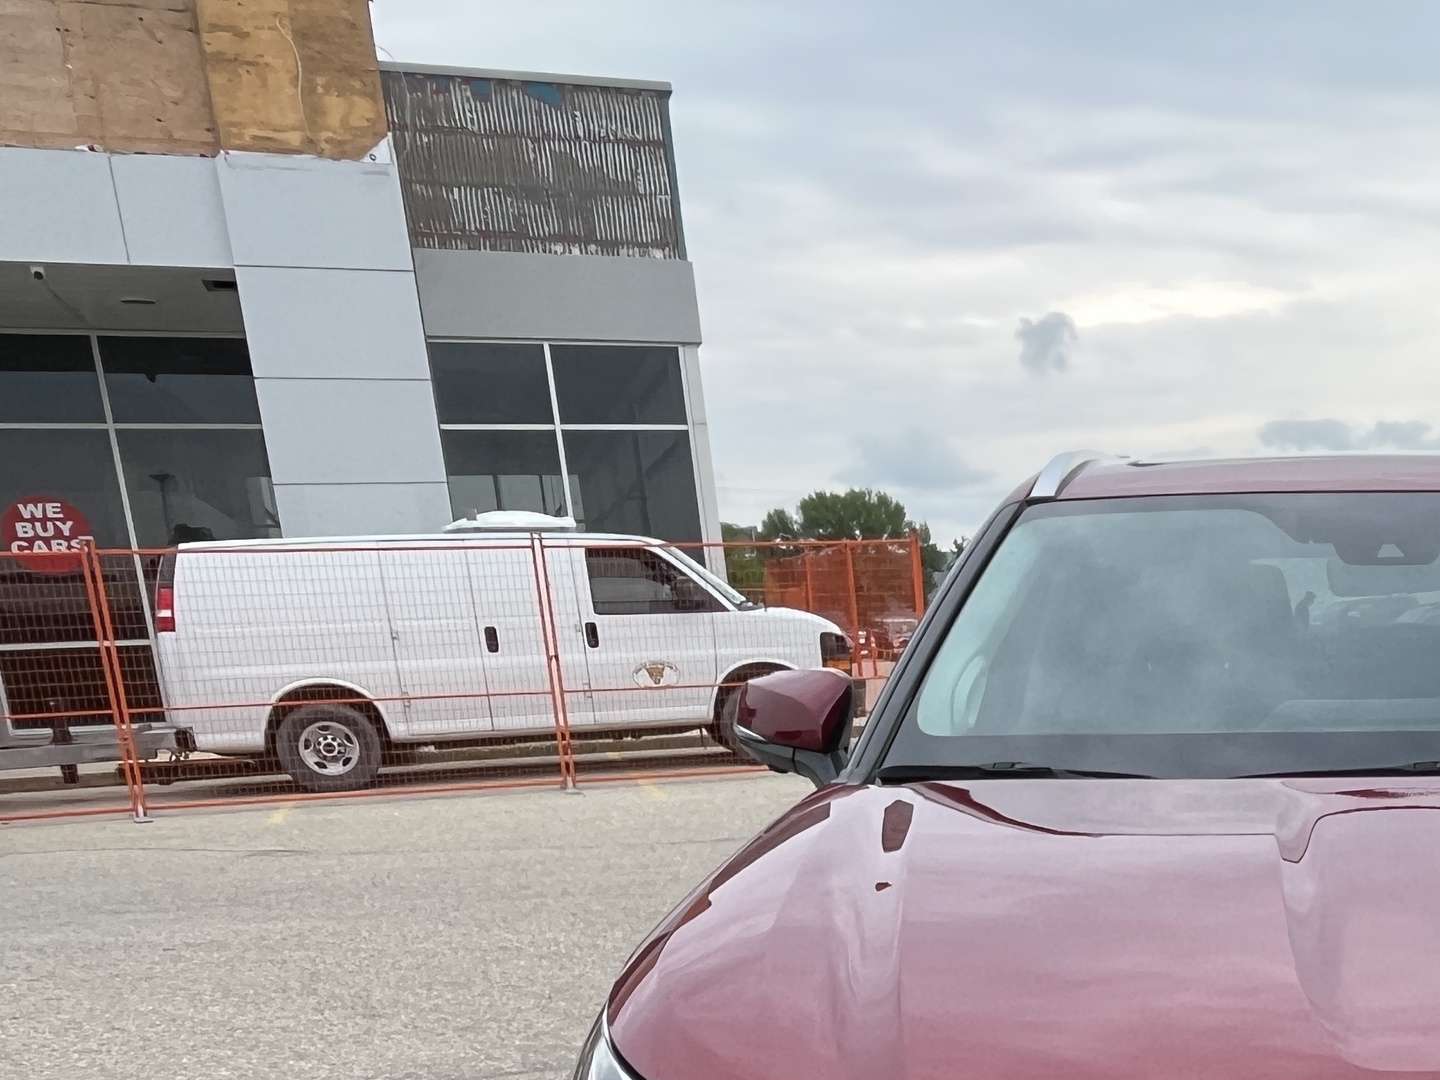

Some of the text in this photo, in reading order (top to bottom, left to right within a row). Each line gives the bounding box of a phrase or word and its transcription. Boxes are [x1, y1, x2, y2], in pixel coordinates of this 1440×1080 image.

[17, 503, 64, 519] WE
[15, 521, 74, 538] BUY
[11, 540, 88, 553] CARS
